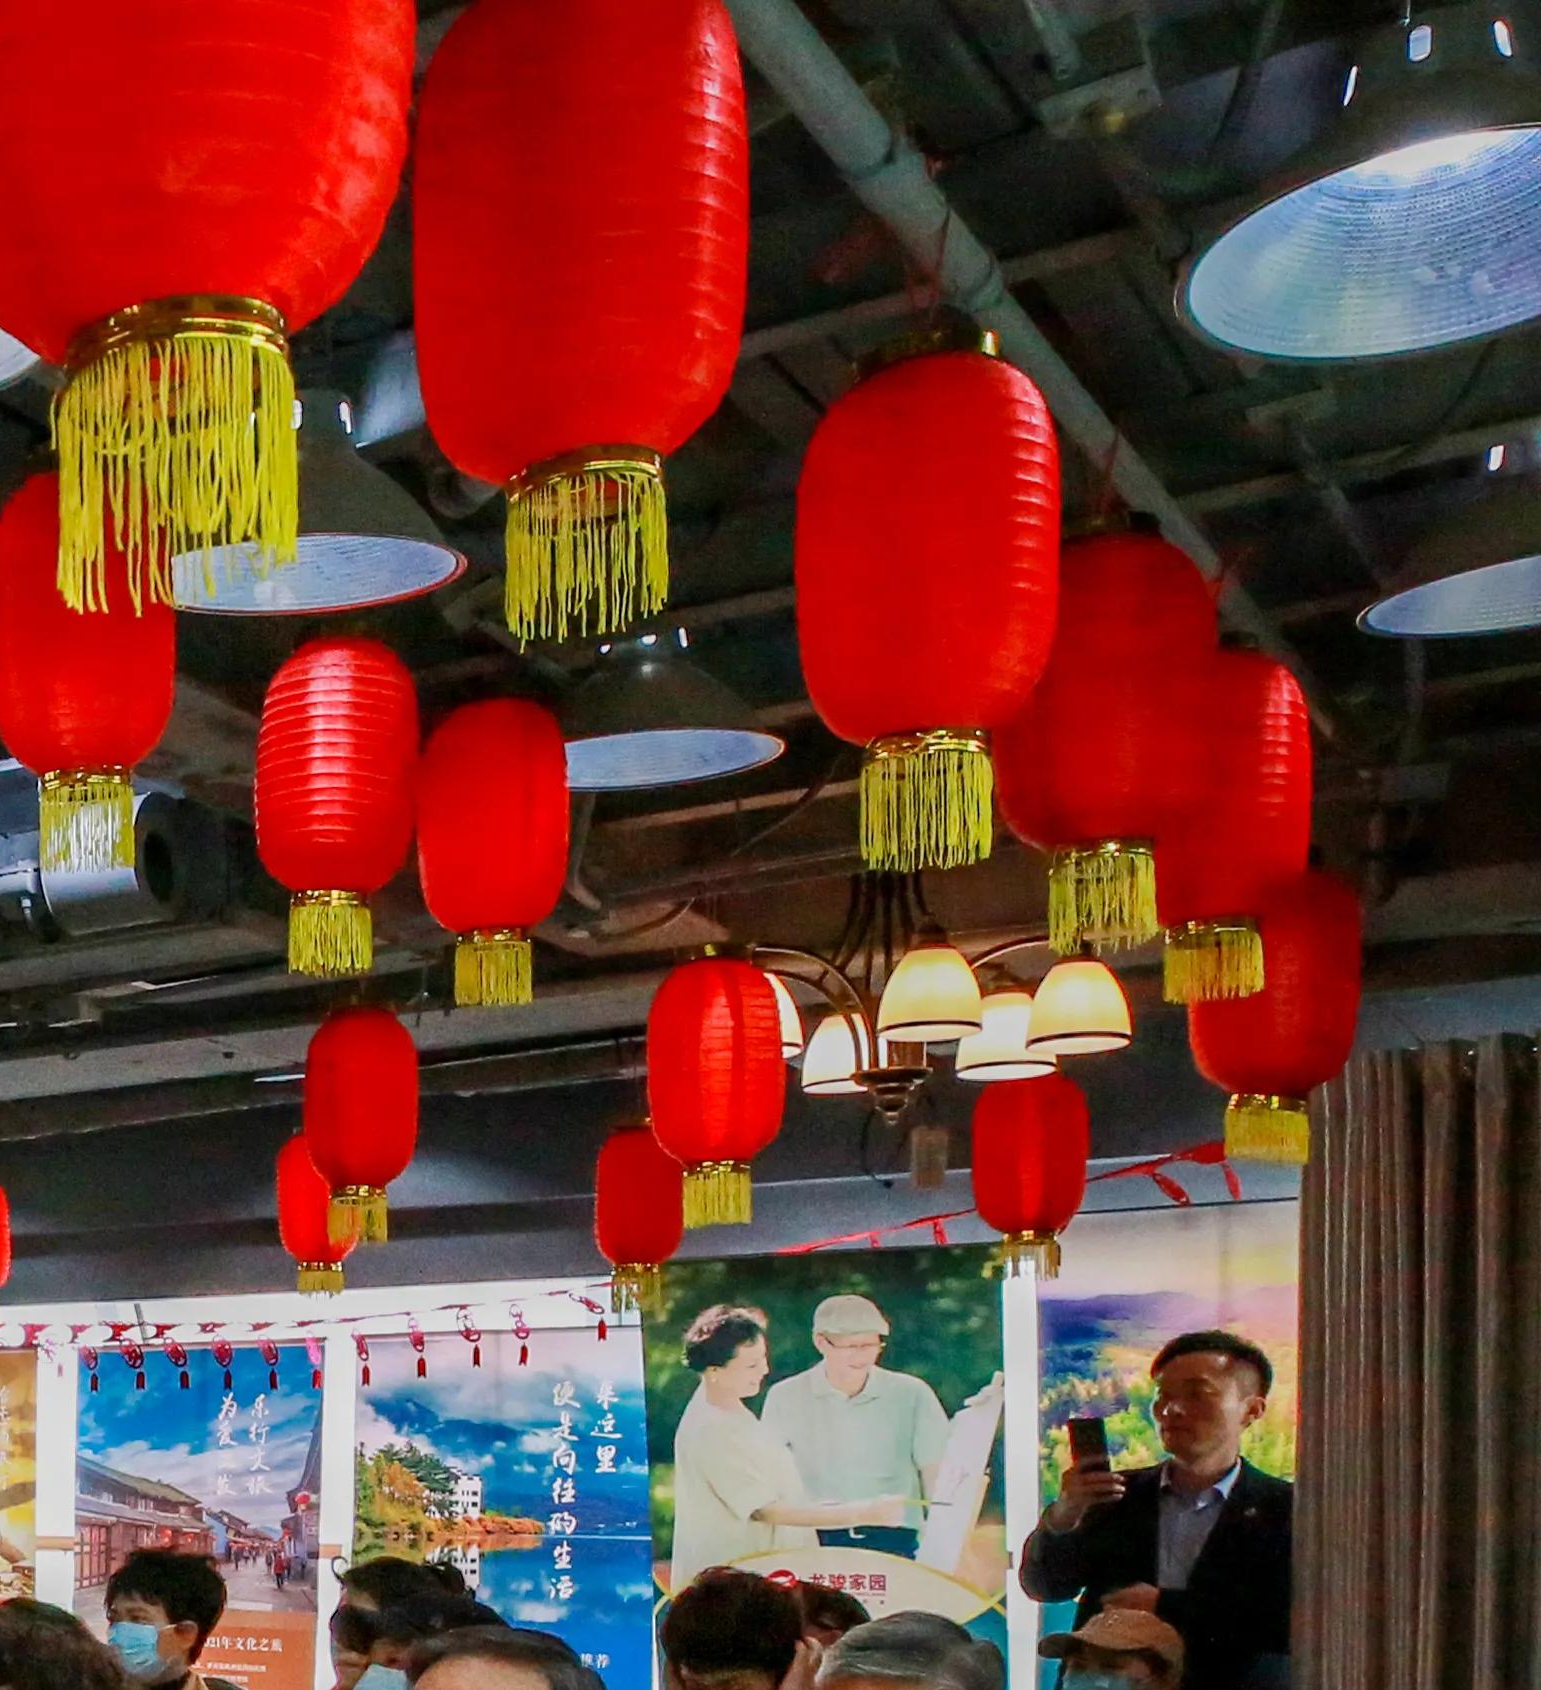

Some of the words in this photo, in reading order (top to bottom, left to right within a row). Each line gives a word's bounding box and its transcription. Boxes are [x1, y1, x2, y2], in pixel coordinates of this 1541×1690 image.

[590, 1380, 622, 1473] 来这里
[547, 1381, 580, 1600] 便是向往的生活
[809, 1573, 886, 1590] 龙骏家园
